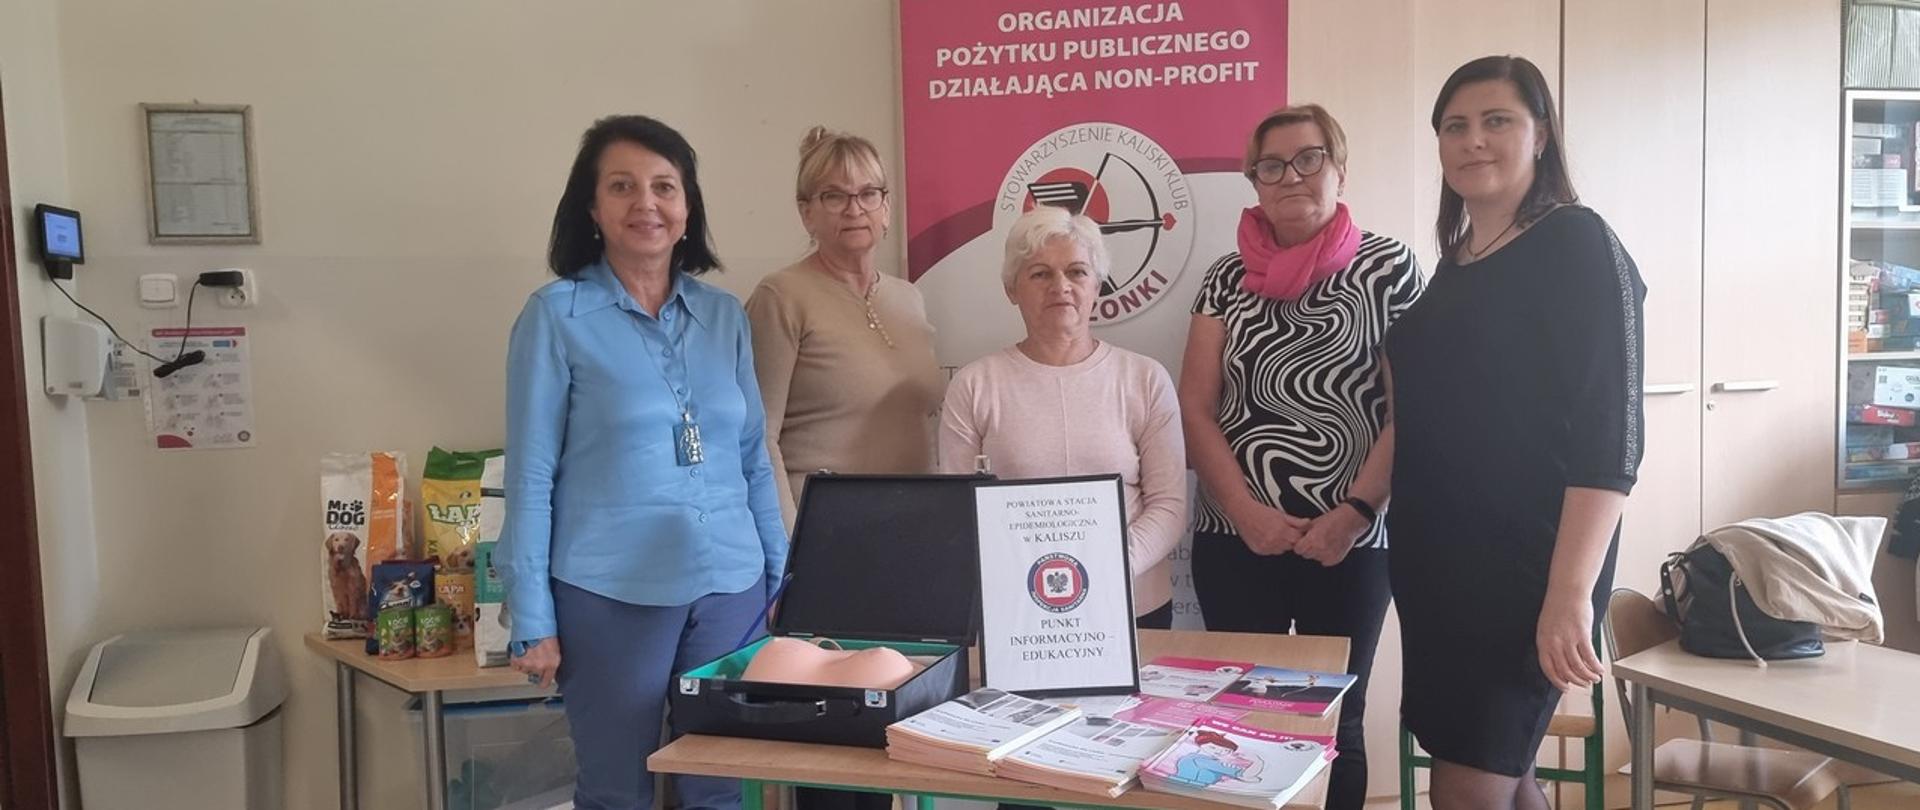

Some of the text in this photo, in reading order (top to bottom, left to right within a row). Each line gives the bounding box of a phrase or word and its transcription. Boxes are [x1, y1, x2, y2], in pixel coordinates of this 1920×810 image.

[997, 2, 1184, 33] ORGANIZACJA
[936, 29, 1251, 67] POŻYTKU PUBLICZNEGO
[929, 61, 1260, 99] DZIAŁAJĄCA NON-PROFIT
[1000, 127, 1189, 212] STOWARZYSZENIE KALISKI KLUB
[328, 500, 348, 511] Mr
[1006, 496, 1098, 508] POWIATOWA STACJA
[326, 510, 365, 526] DOG
[1025, 509, 1079, 518] SANITARNO-
[1008, 518, 1098, 530] EPIDEMIOLOGICZNA
[1034, 531, 1086, 542] KALISZU
[1040, 618, 1081, 629] PUNKT
[1010, 631, 1105, 646] INFORMACYJNO
[1022, 647, 1104, 661] EDUKACYJNY
